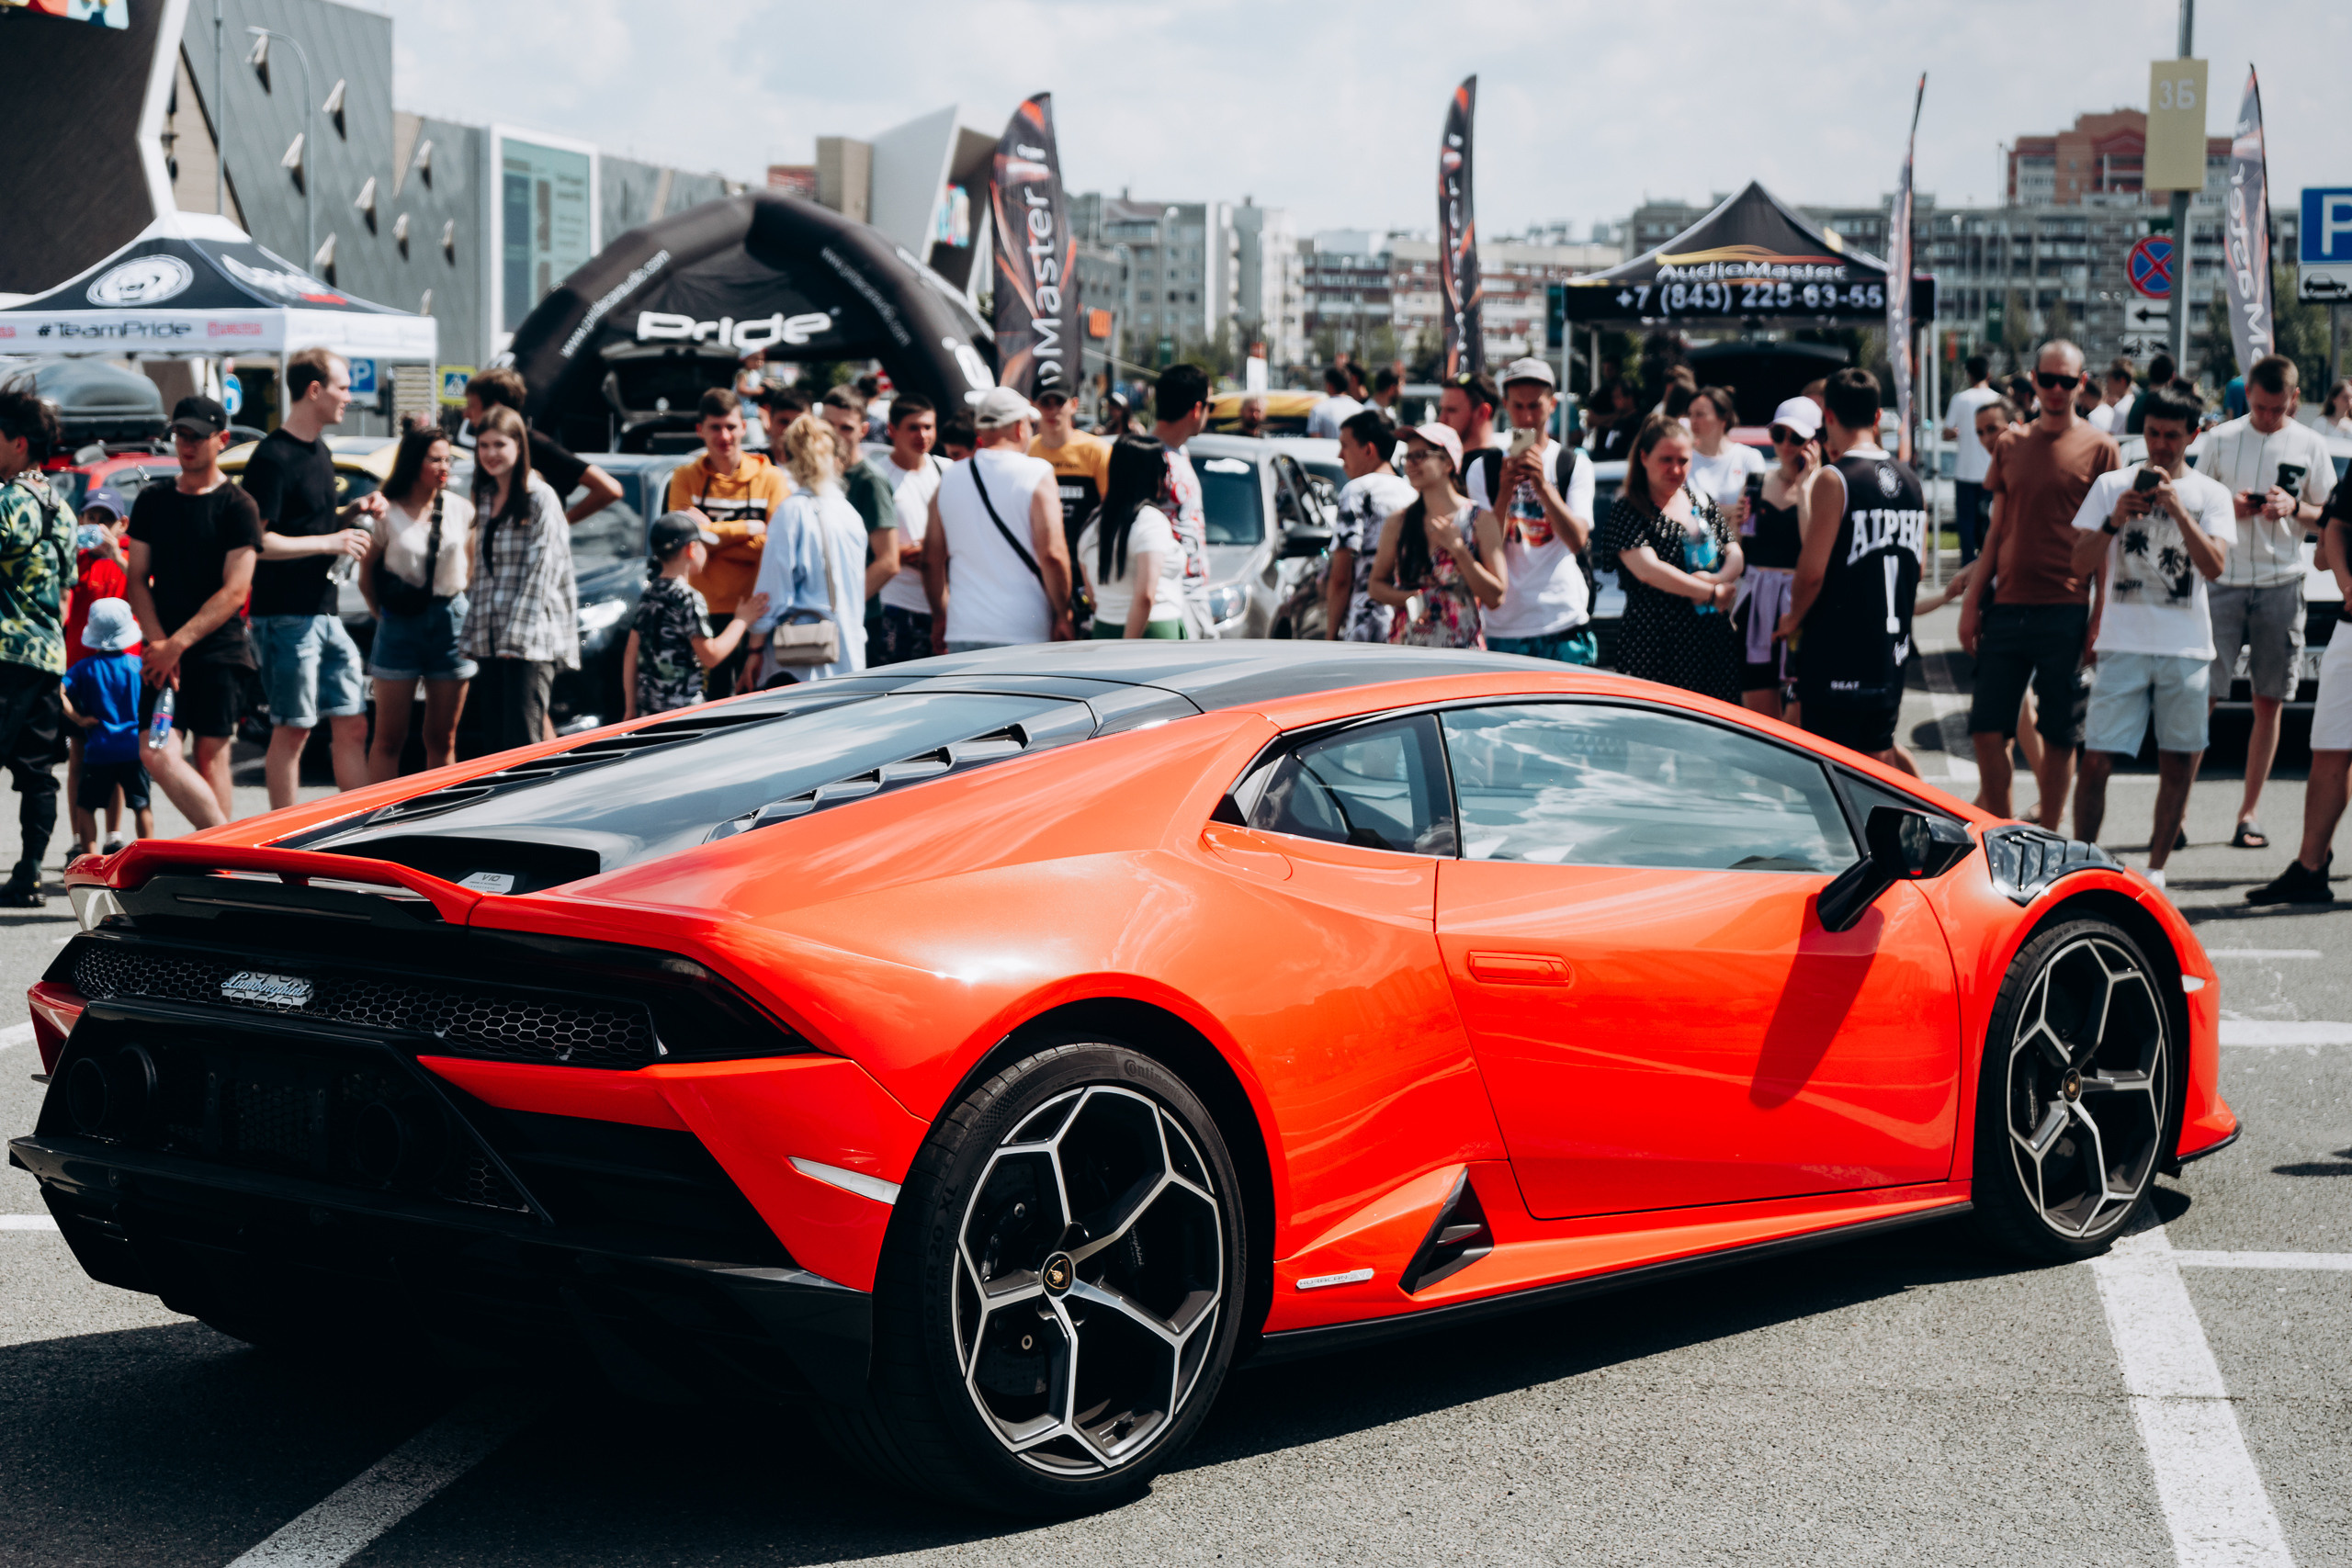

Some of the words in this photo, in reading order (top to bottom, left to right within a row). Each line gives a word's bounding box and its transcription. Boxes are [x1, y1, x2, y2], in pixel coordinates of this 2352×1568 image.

[2322, 194, 2352, 255] P
[1656, 261, 1848, 281] AudioMaster
[559, 249, 671, 359] www.pridecaraudio.com
[1616, 285, 1651, 310] +7
[1660, 282, 1732, 315] (843)
[1741, 281, 1883, 309] 225-63-55
[37, 321, 191, 338] #TeamPride
[637, 310, 831, 349] Pride
[354, 361, 371, 387] P
[1847, 508, 1927, 565] ALPHA
[220, 971, 311, 998] Lamborghini
